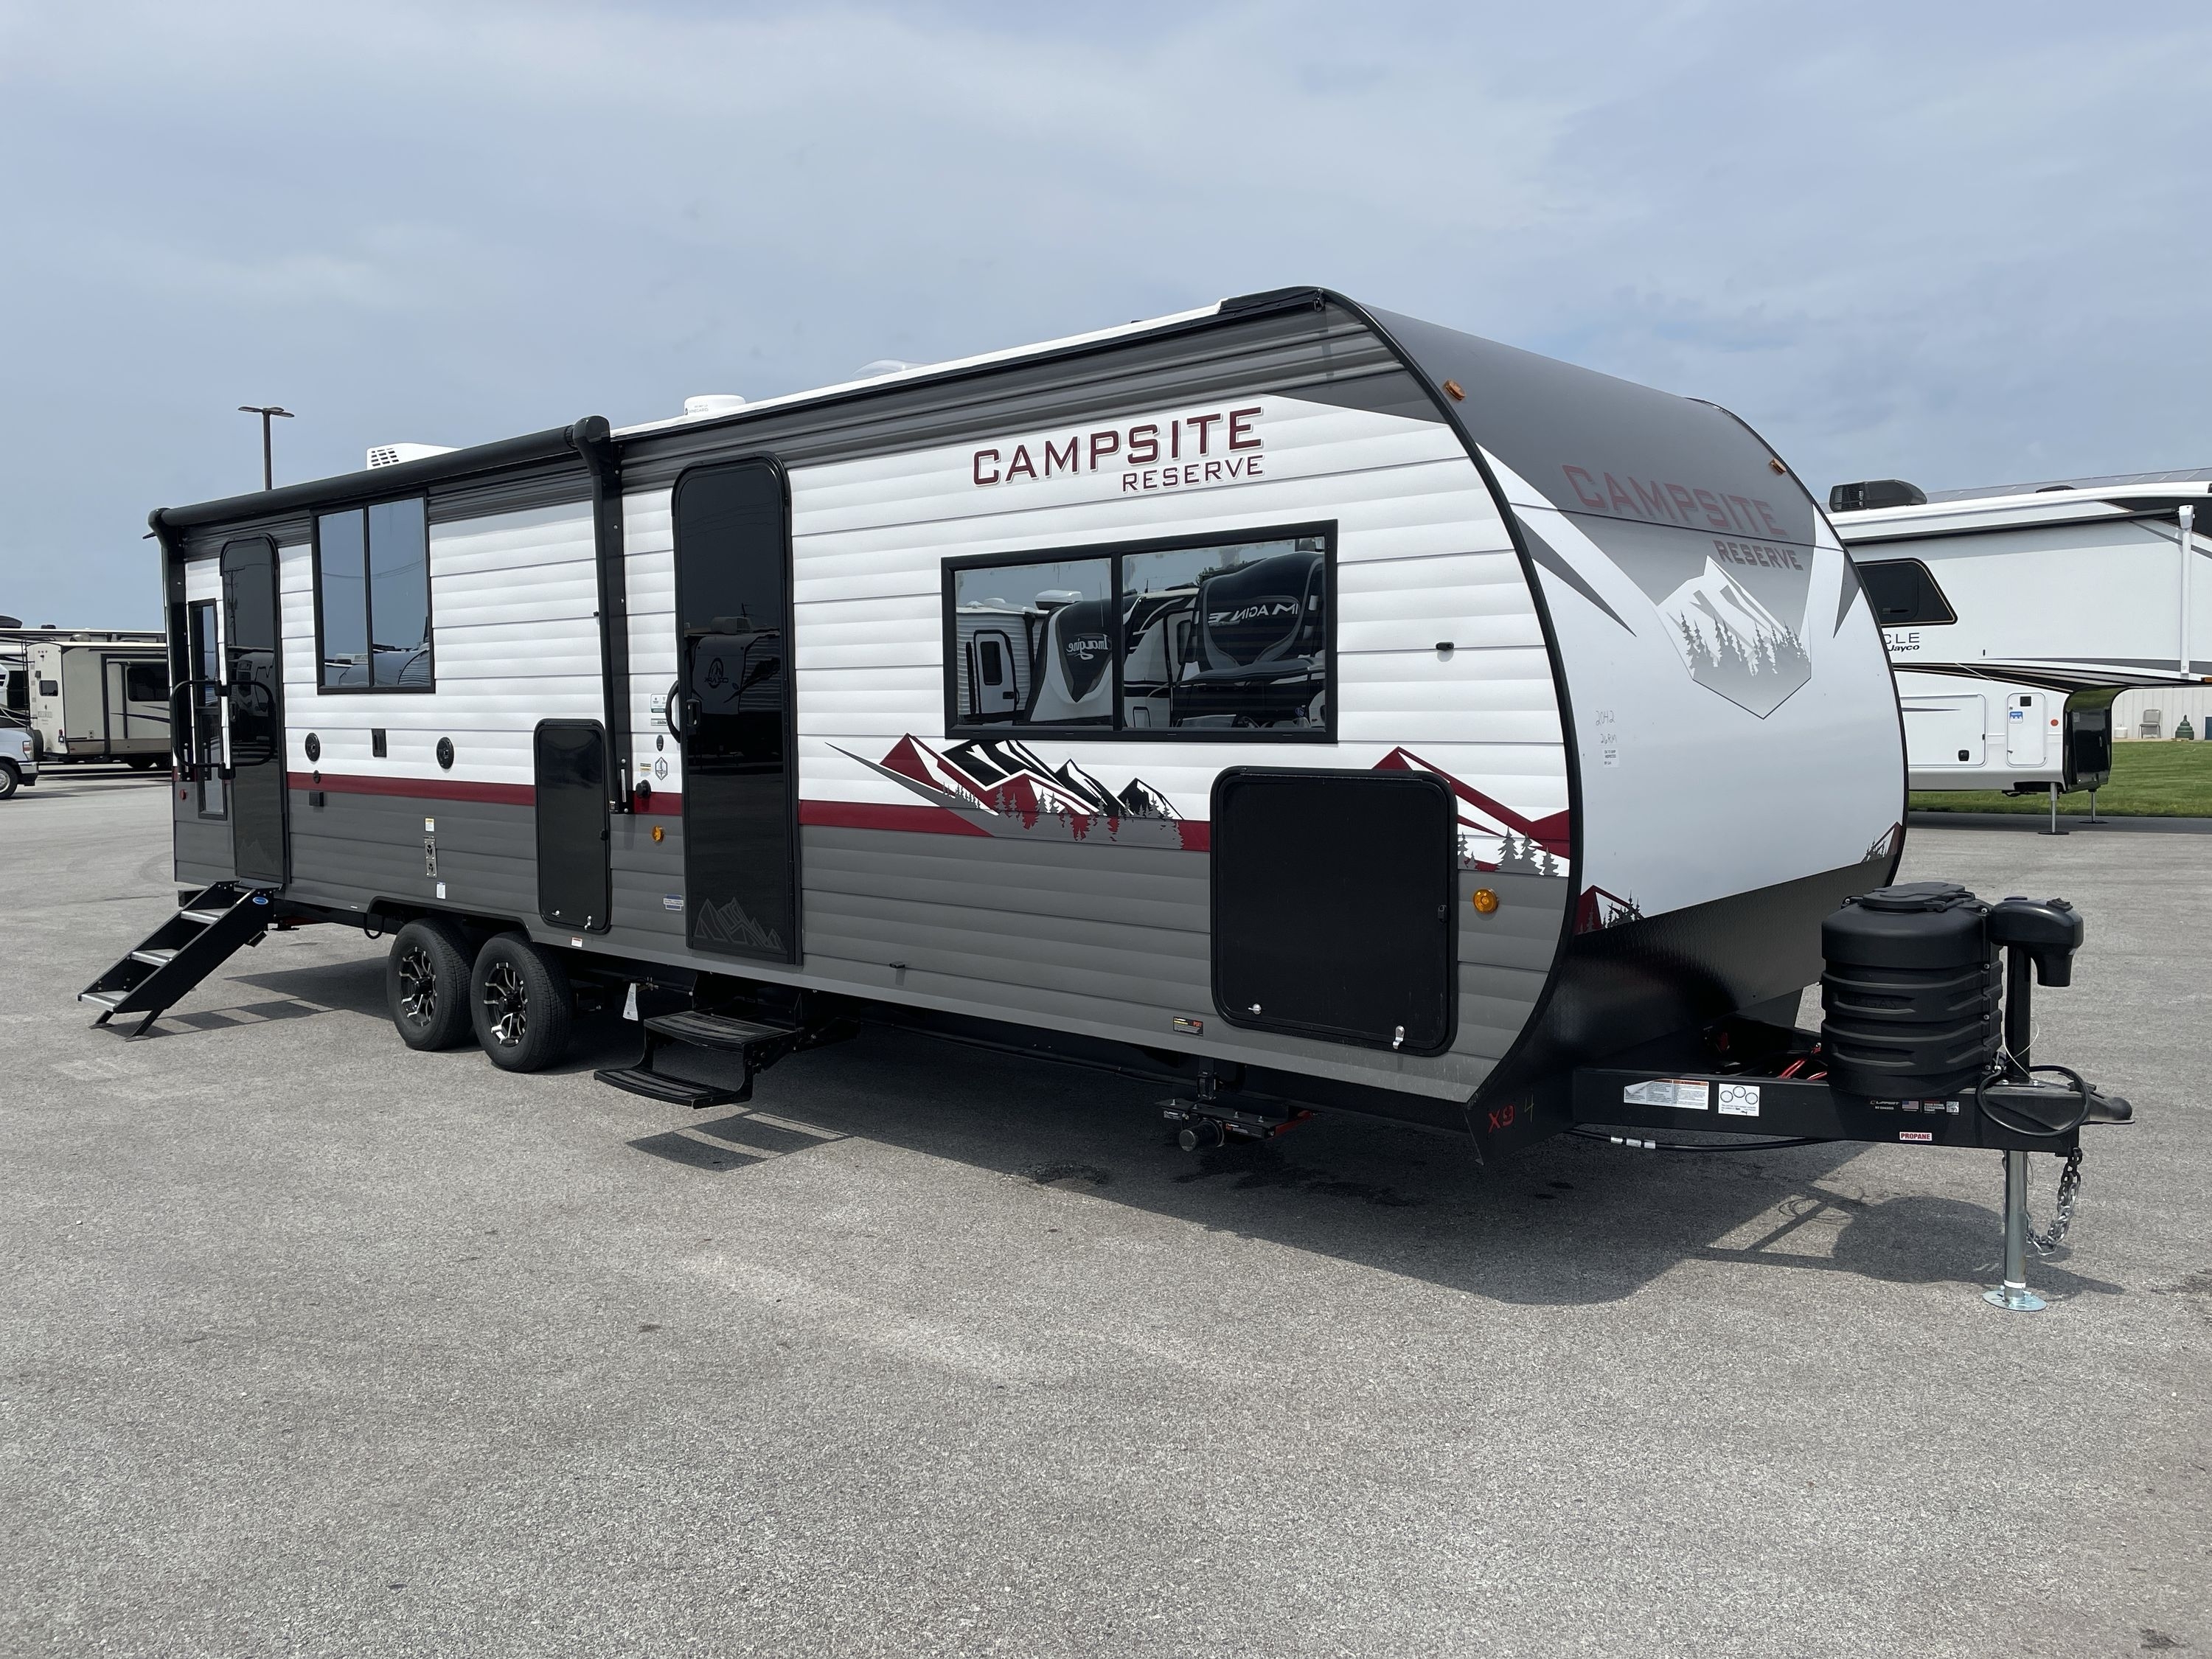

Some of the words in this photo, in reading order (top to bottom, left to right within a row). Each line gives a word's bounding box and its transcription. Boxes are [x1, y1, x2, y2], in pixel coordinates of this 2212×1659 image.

[973, 406, 1262, 485] CAMPSITE
[1123, 454, 1264, 492] RESERVE
[1562, 465, 1788, 536] CAMPSITE
[1713, 539, 1804, 571] RESERVE
